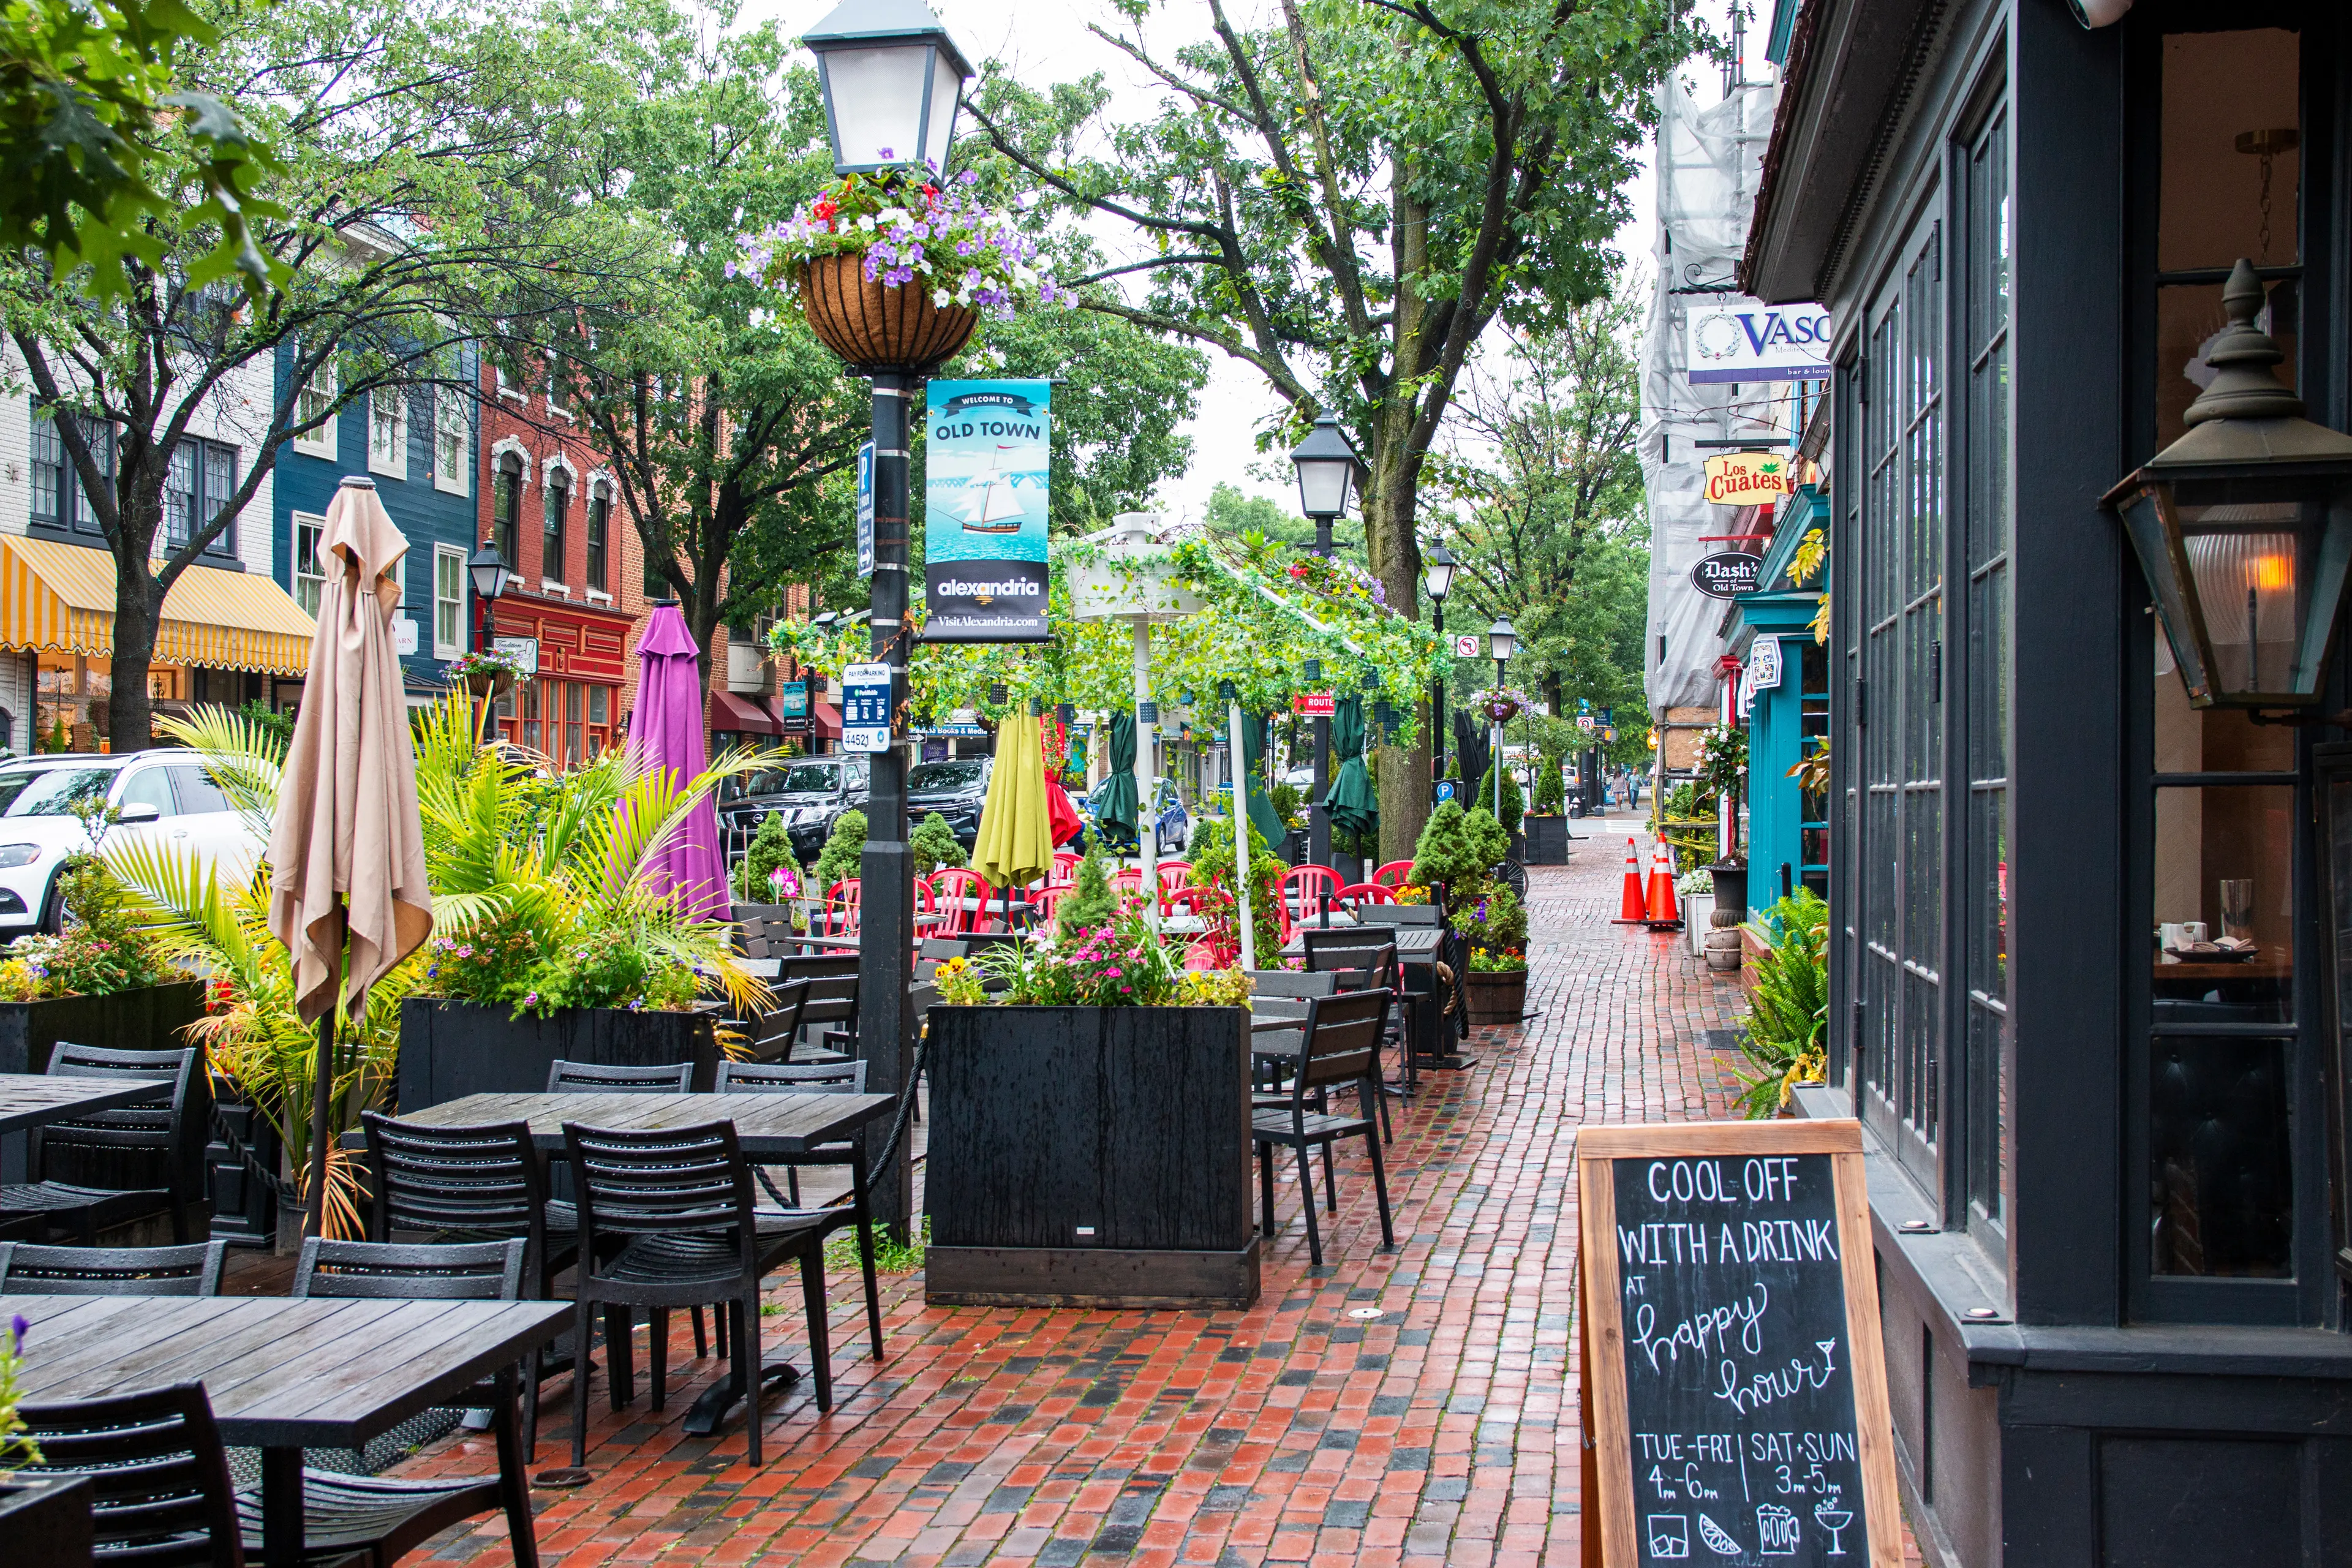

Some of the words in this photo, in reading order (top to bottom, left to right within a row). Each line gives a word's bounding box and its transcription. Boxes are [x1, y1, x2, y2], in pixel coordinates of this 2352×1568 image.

[962, 396, 1000, 405] WELCOME
[936, 423, 974, 440] OLD
[980, 421, 1040, 440] TOWN
[861, 456, 868, 489] P
[1723, 461, 1747, 477] Los
[1711, 472, 1782, 499] Cuates
[938, 577, 1039, 596] alexandria
[938, 616, 1038, 627] VisitAlexandria.com
[845, 734, 869, 745] 44521
[1441, 785, 1449, 796] P
[1648, 1160, 1737, 1202] COOL
[1744, 1158, 1799, 1202] OFF
[1617, 1222, 1708, 1264] WITH
[1719, 1222, 1740, 1264] A
[1743, 1219, 1838, 1262] DRINK
[1626, 1275, 1646, 1295] AT
[1632, 1282, 1768, 1376] happy
[1714, 1359, 1833, 1414] hour
